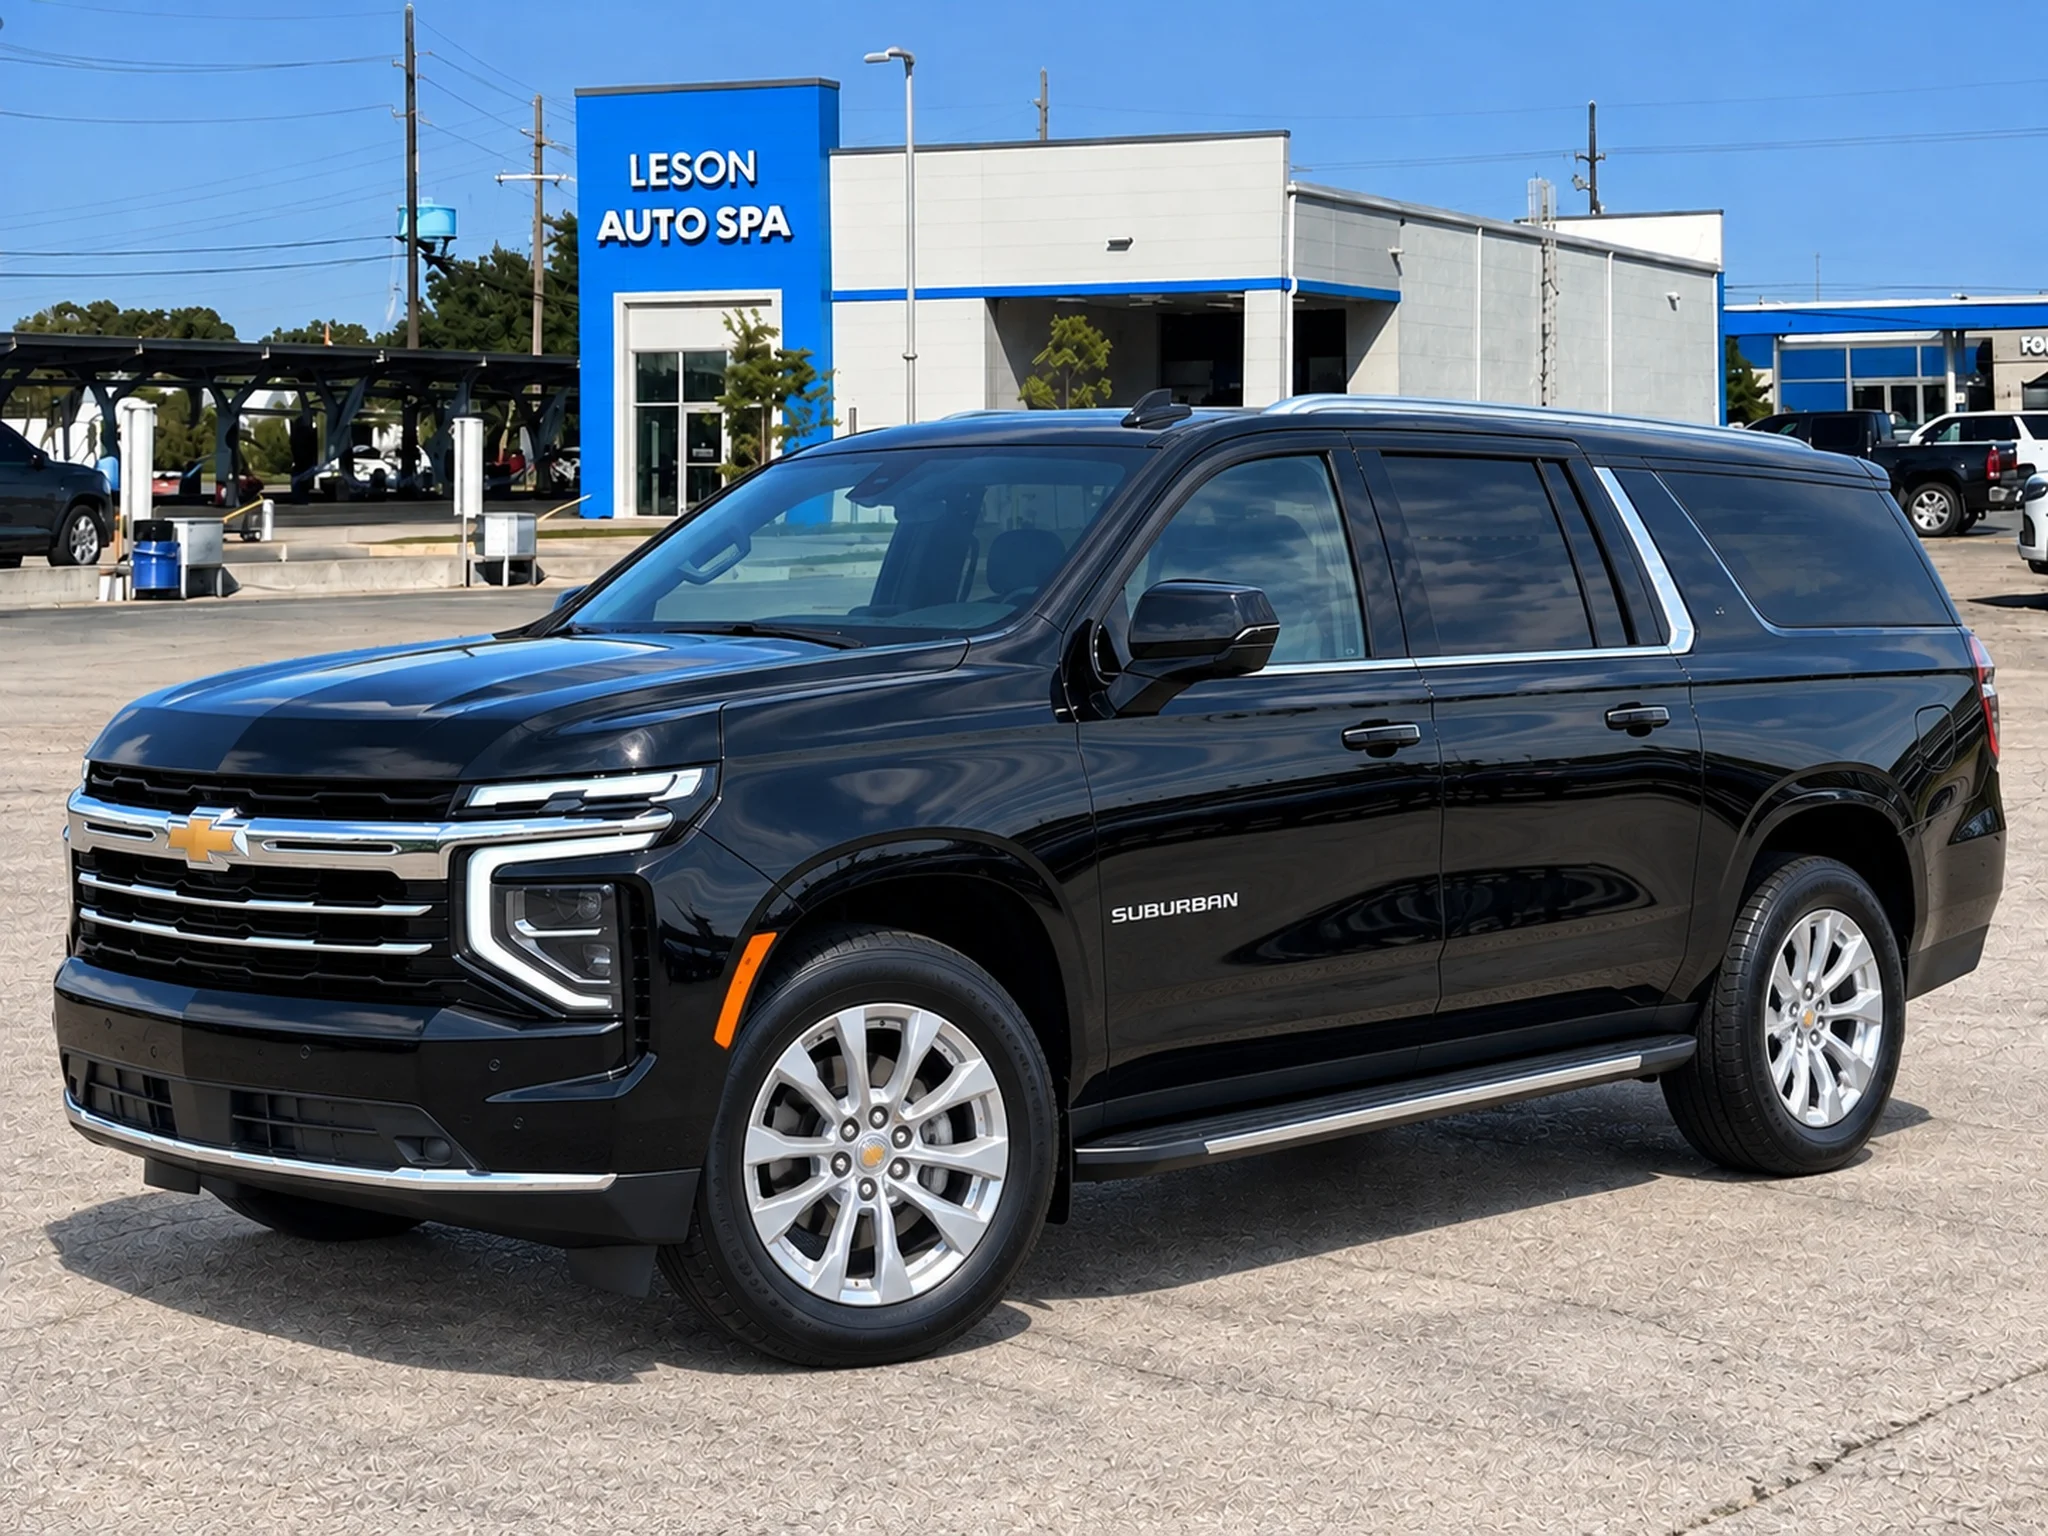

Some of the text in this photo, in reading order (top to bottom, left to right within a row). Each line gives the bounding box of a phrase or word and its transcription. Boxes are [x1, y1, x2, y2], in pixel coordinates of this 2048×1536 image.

[629, 150, 756, 187] LESON
[596, 205, 792, 242] AUTO SPA
[2021, 336, 2048, 354] FO
[1111, 892, 1239, 924] SUBURBAN
